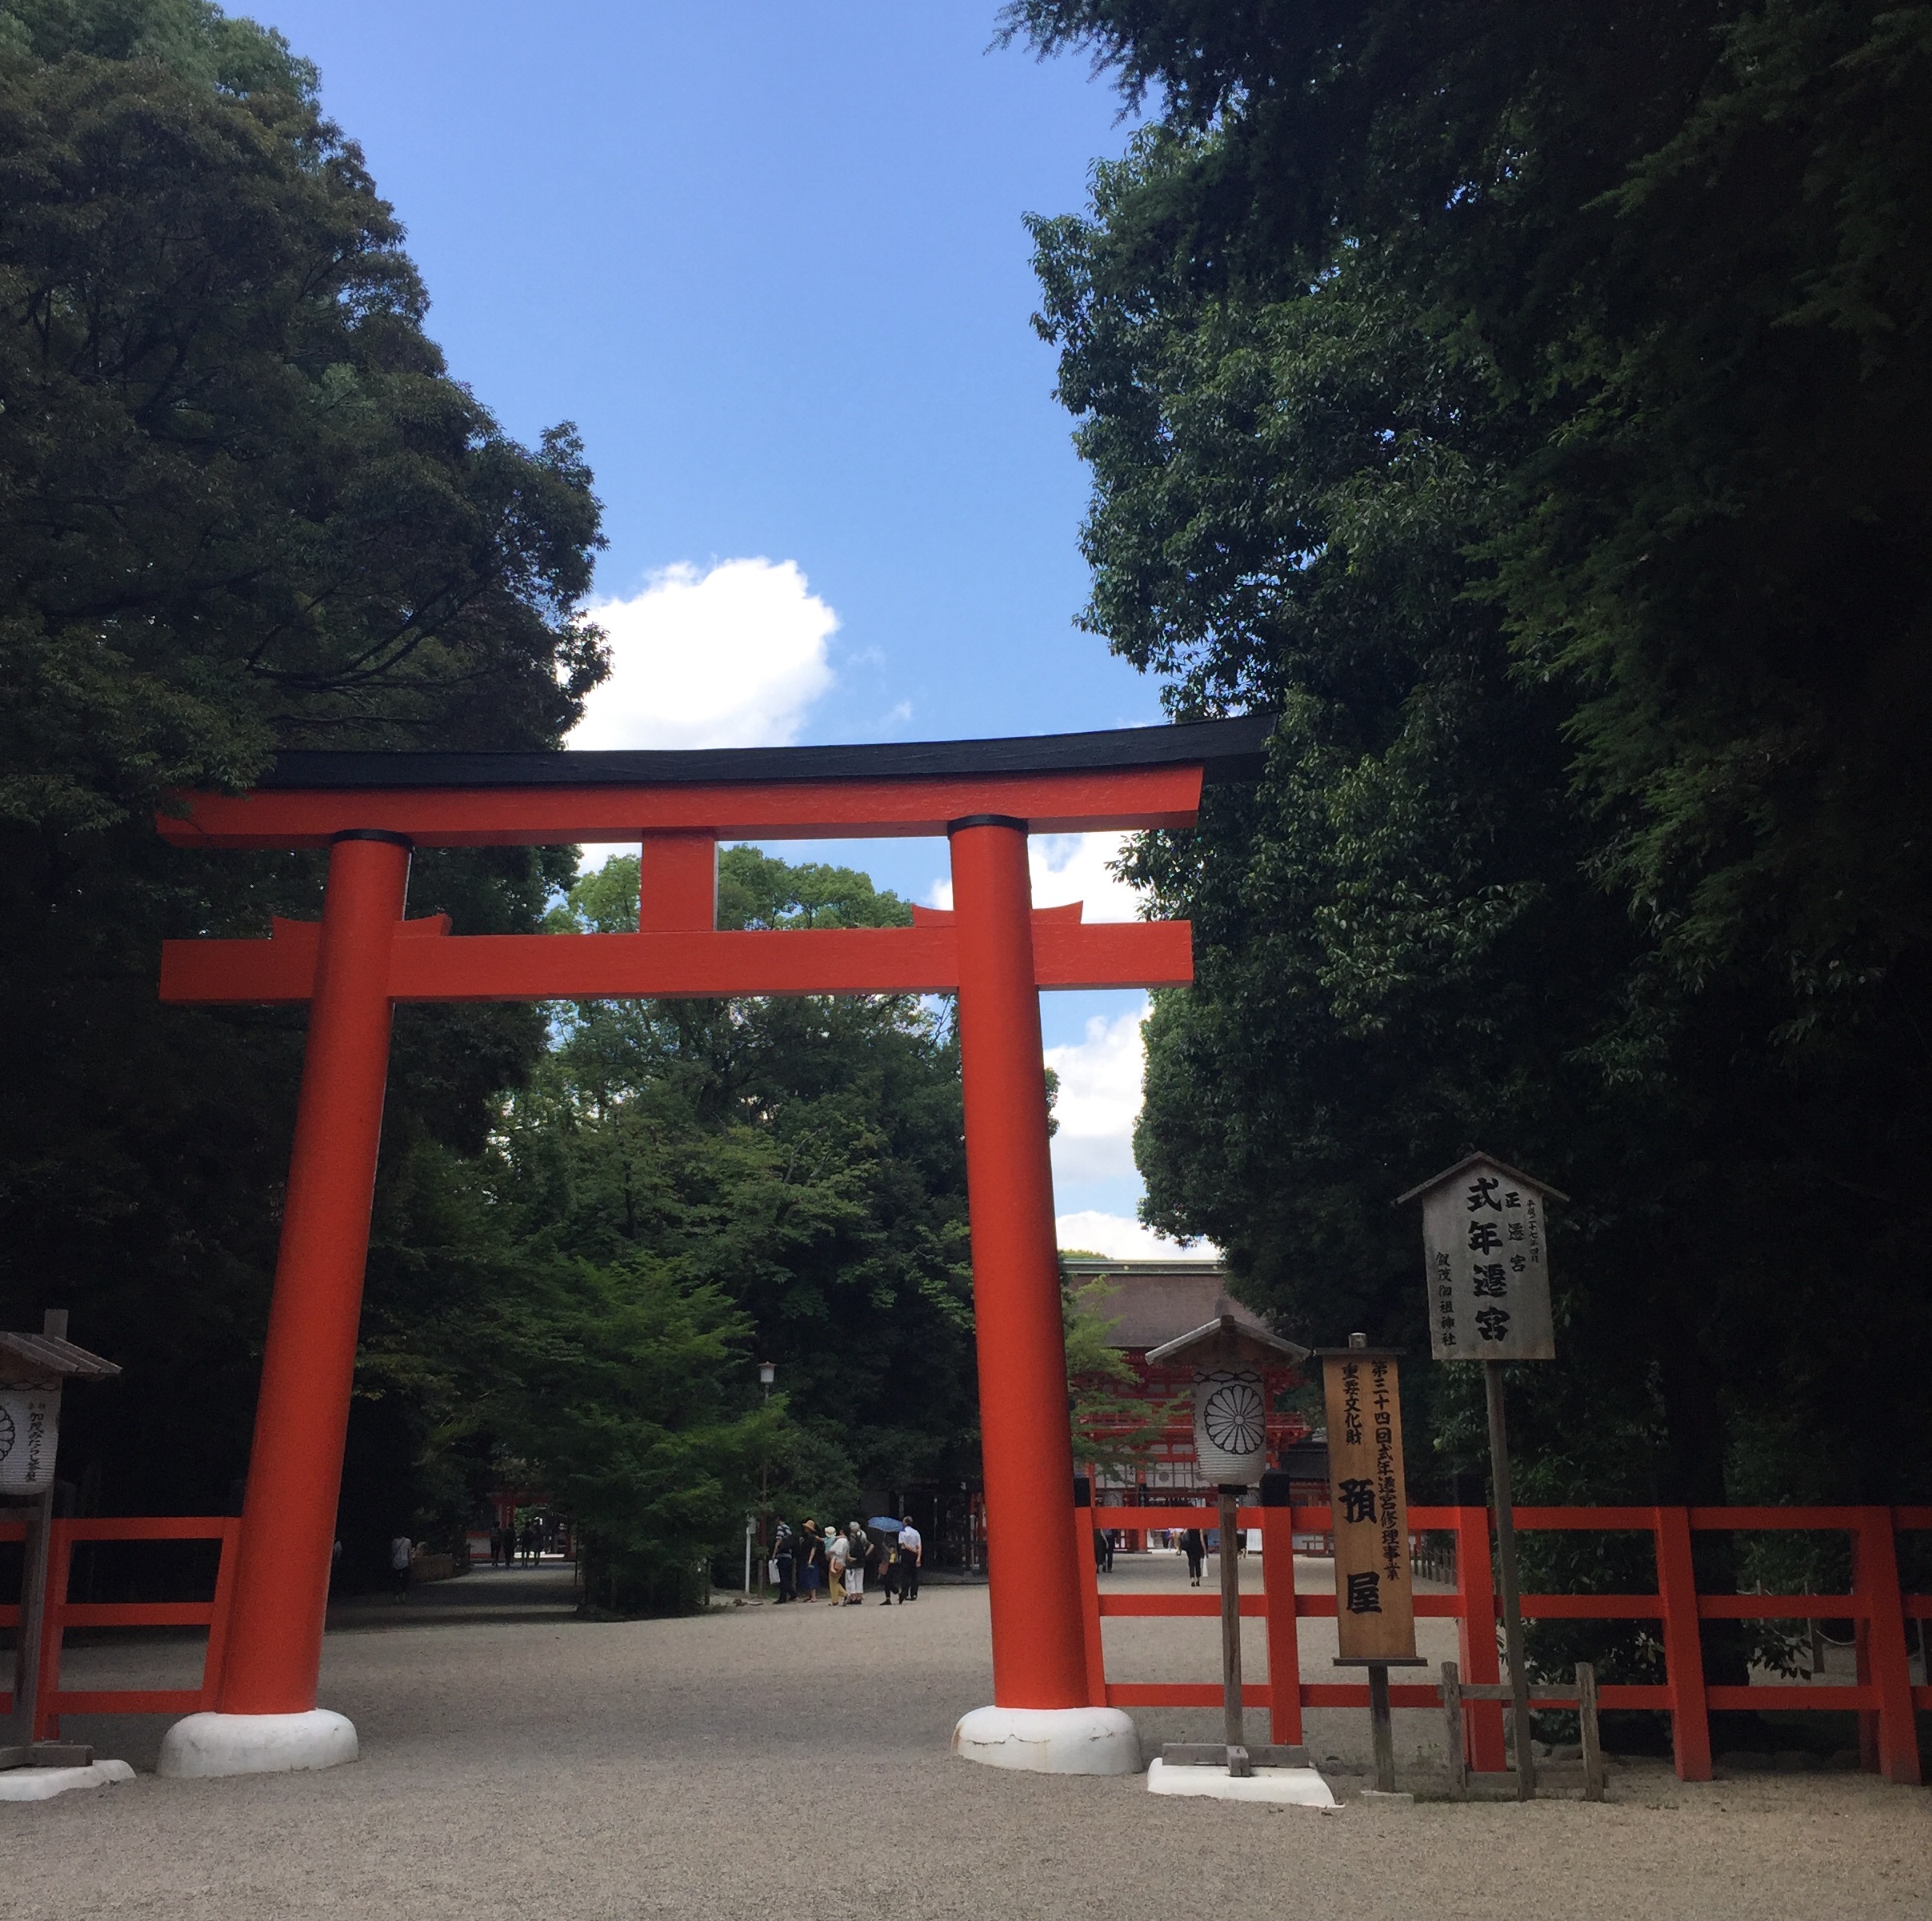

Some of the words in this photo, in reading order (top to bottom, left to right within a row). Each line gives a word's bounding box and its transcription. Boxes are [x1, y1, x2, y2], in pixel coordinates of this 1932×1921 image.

[1466, 1177, 1510, 1342] 式年遷宮
[1505, 1191, 1526, 1272] 正遷宮
[1436, 1252, 1457, 1347] 賀茂御祖神社
[1342, 1363, 1362, 1446] 重要文化財
[1338, 1479, 1382, 1615] 預屋
